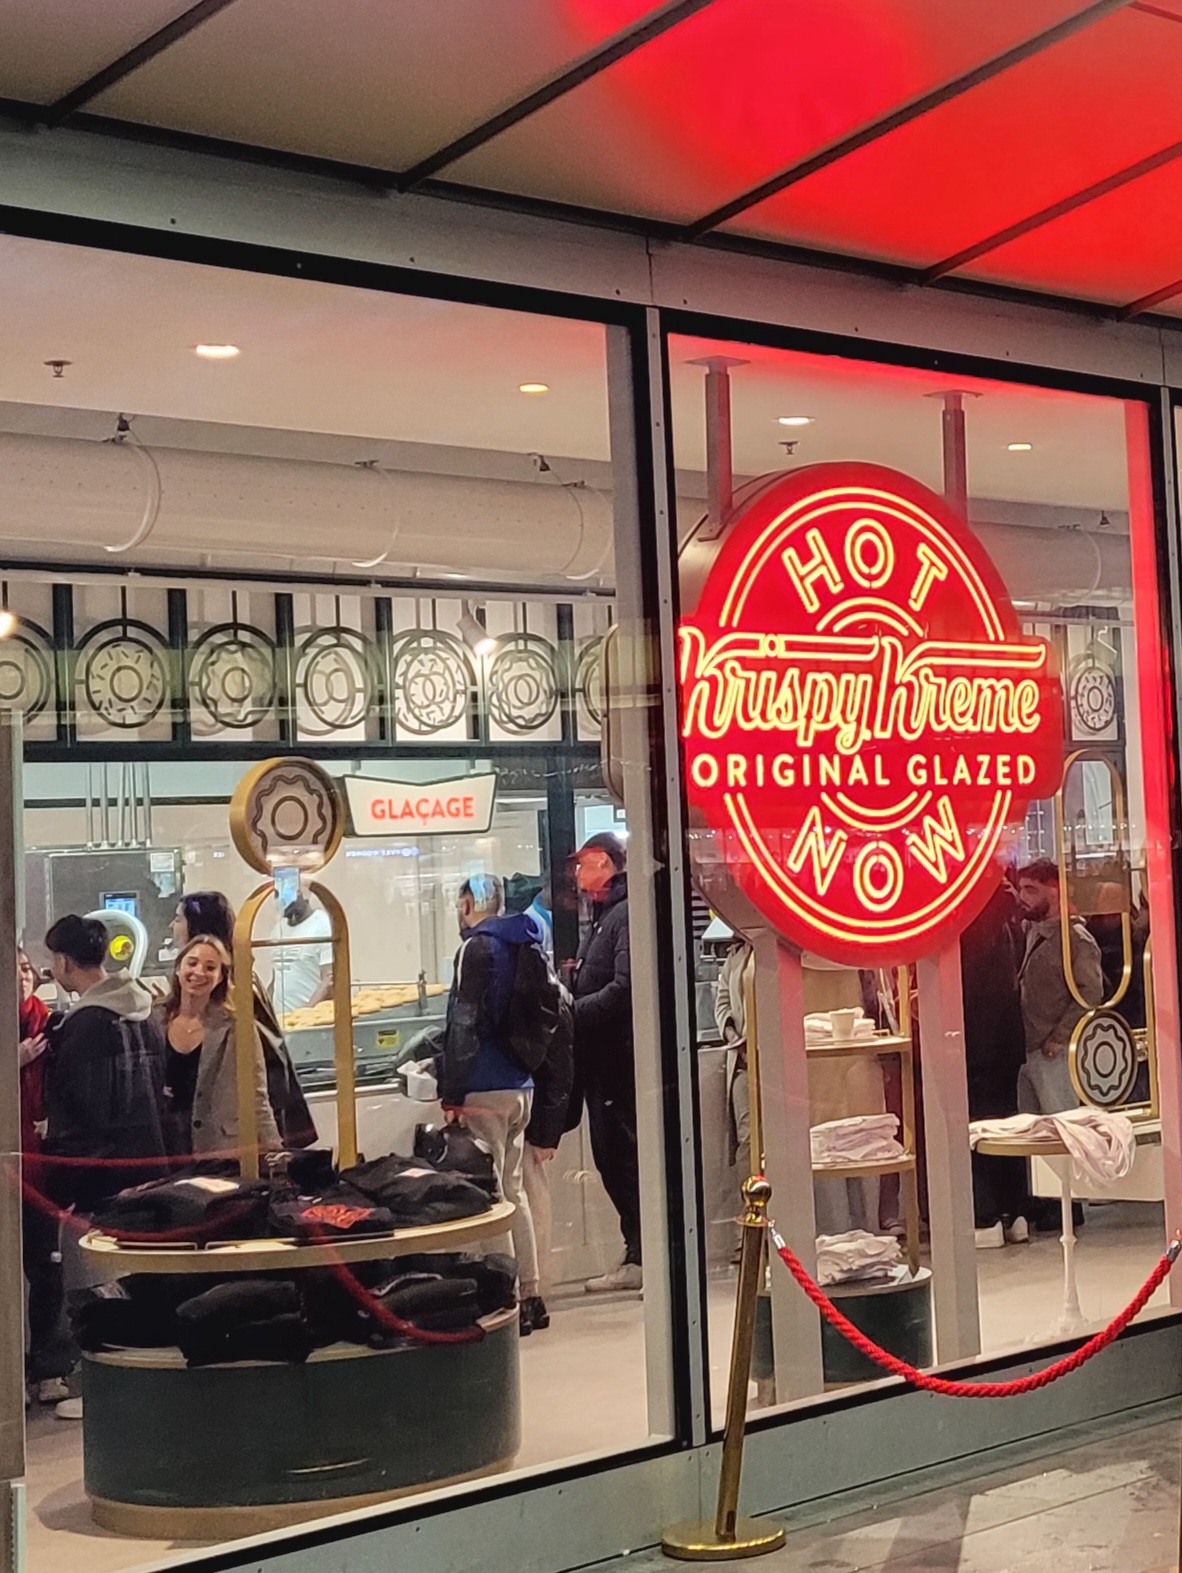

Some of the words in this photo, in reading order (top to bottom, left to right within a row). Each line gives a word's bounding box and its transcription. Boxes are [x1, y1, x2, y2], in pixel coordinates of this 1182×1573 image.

[781, 518, 948, 613] HOT
[678, 628, 880, 755] Krispy
[876, 636, 1046, 740] Kreme
[371, 796, 475, 826] GLAÇAGE
[692, 753, 891, 787] ORIGINAL
[906, 754, 1037, 786] GLAZED
[787, 795, 965, 914] NOW
